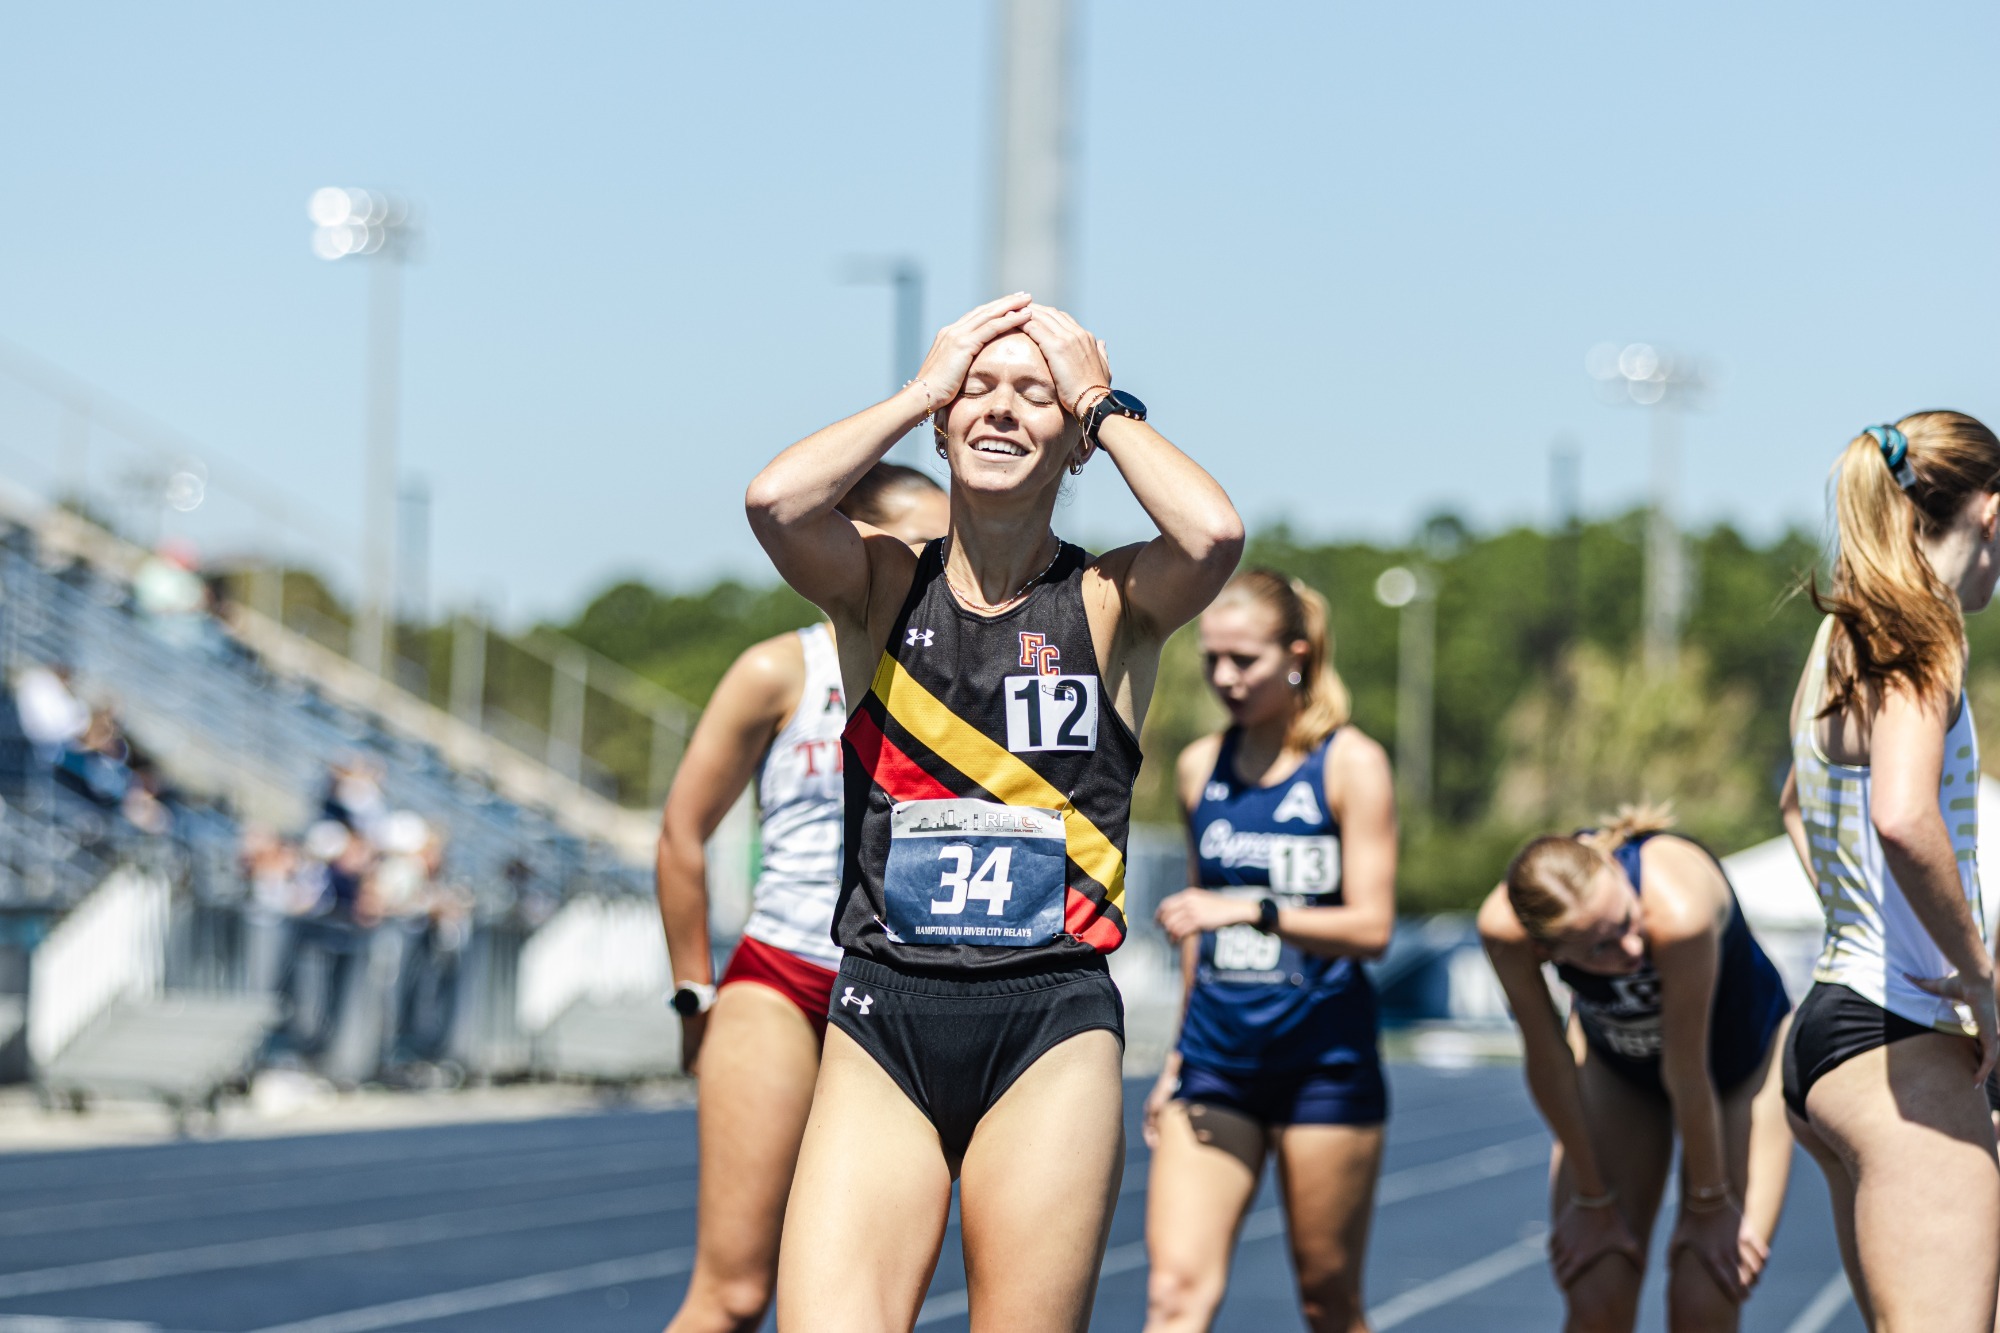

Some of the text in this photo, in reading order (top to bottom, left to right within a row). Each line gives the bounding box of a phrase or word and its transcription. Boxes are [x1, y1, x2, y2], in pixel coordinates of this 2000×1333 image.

[1019, 632, 1060, 676] FC
[1014, 679, 1089, 747] 12
[931, 846, 1013, 915] 34
[1282, 848, 1326, 887] 13
[915, 926, 1032, 937] HAMPTON INN RIVER CITY RELAYS
